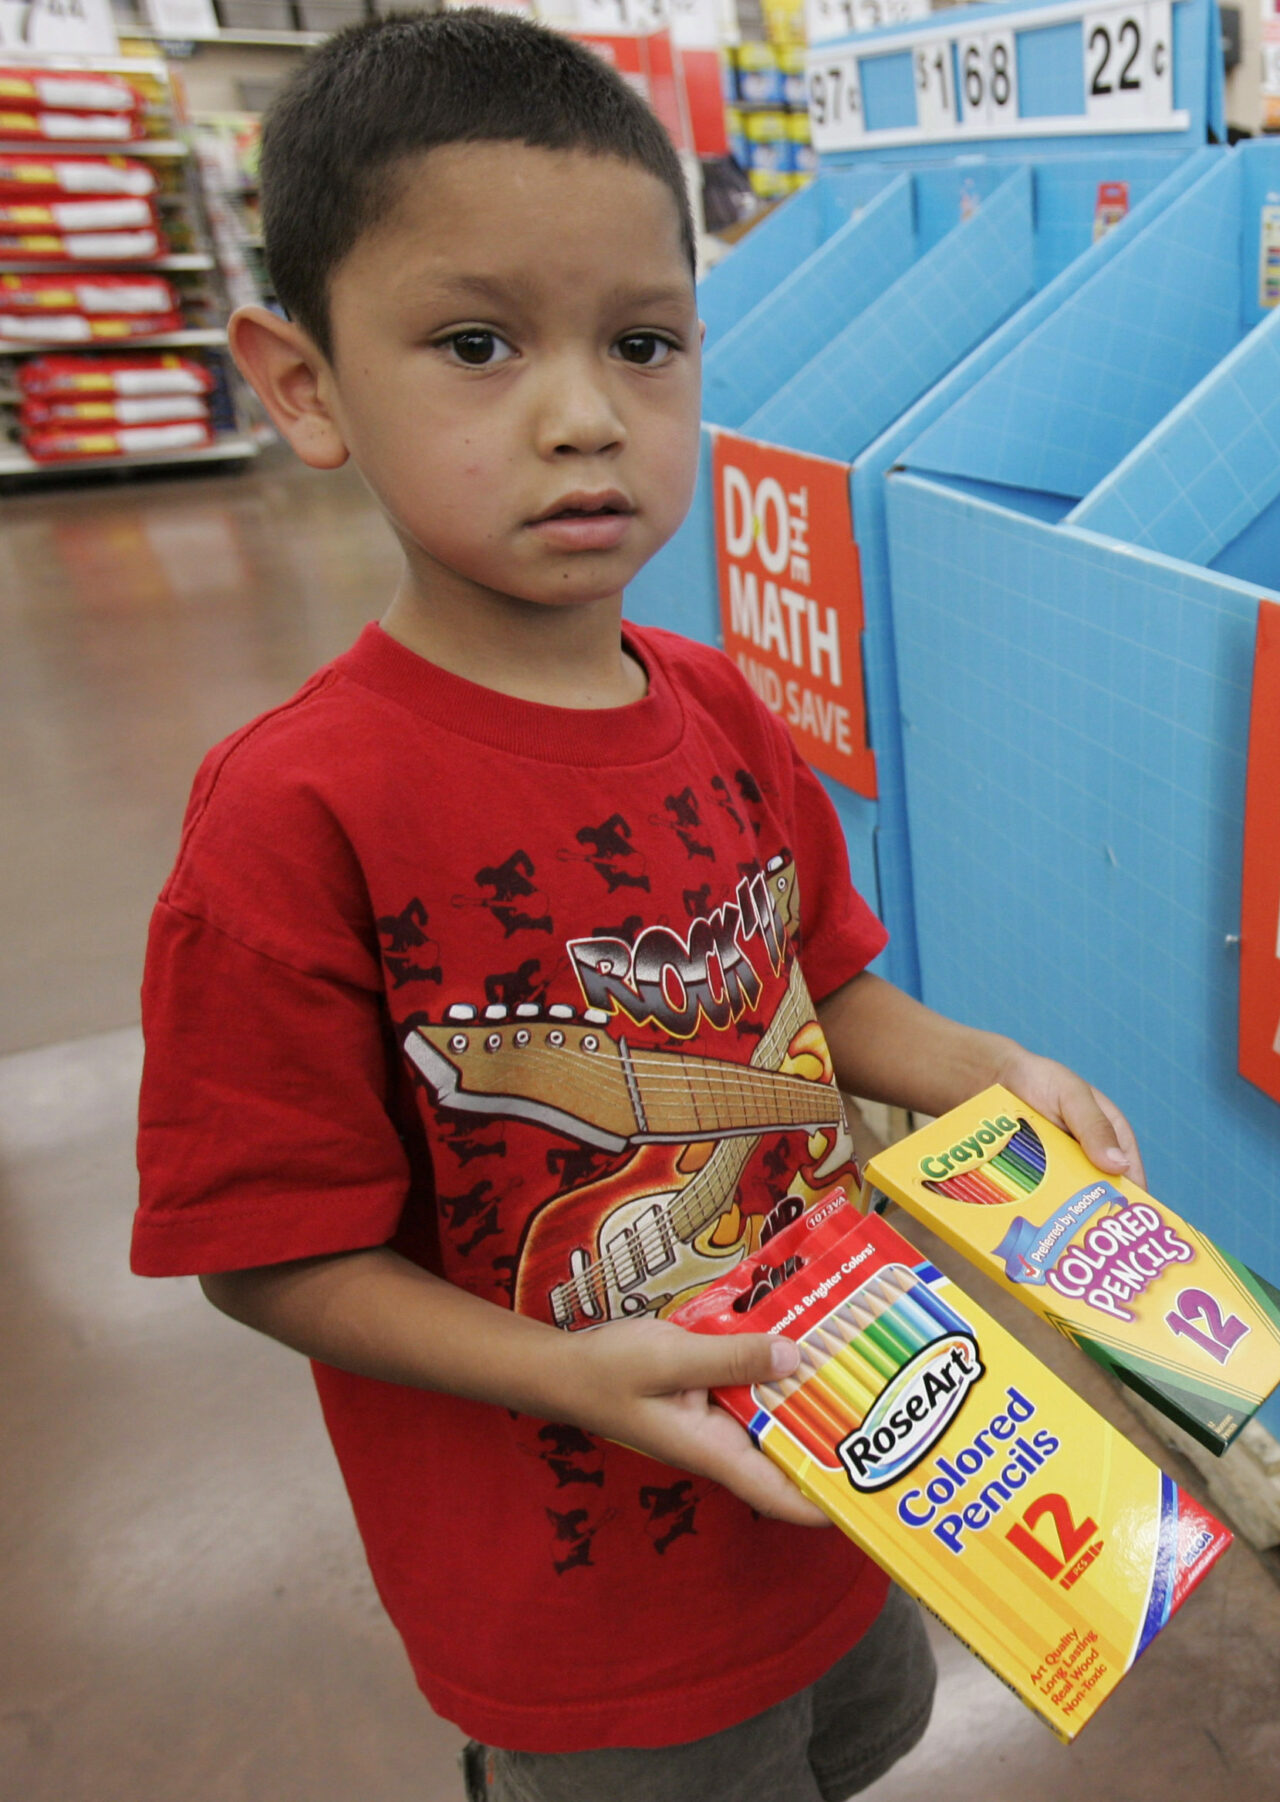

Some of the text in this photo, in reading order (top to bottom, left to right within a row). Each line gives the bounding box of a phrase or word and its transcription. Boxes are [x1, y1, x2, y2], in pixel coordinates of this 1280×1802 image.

[723, 464, 790, 575] DO
[787, 486, 811, 586] THE
[728, 562, 843, 688] MATH
[785, 679, 852, 756] SAVE
[920, 1112, 1019, 1180] Crayola
[1031, 1186, 1106, 1263] Preferred by Teachers
[1049, 1205, 1161, 1299] COLORED
[801, 1270, 843, 1307] Brighter
[840, 1243, 877, 1275] Colors!
[1088, 1229, 1191, 1322] PENCILS
[1165, 1288, 1250, 1365] 12
[845, 1348, 974, 1479] RoseArt
[898, 1386, 1036, 1529] Colored
[932, 1428, 1060, 1555] Pencils
[1005, 1493, 1099, 1580] 12
[1030, 1627, 1079, 1686] Art Quality
[1039, 1666, 1068, 1696] Long
[1062, 1629, 1098, 1668] Lasting
[1051, 1647, 1099, 1706] Real Wood
[1061, 1663, 1108, 1717] Non-Toxic
